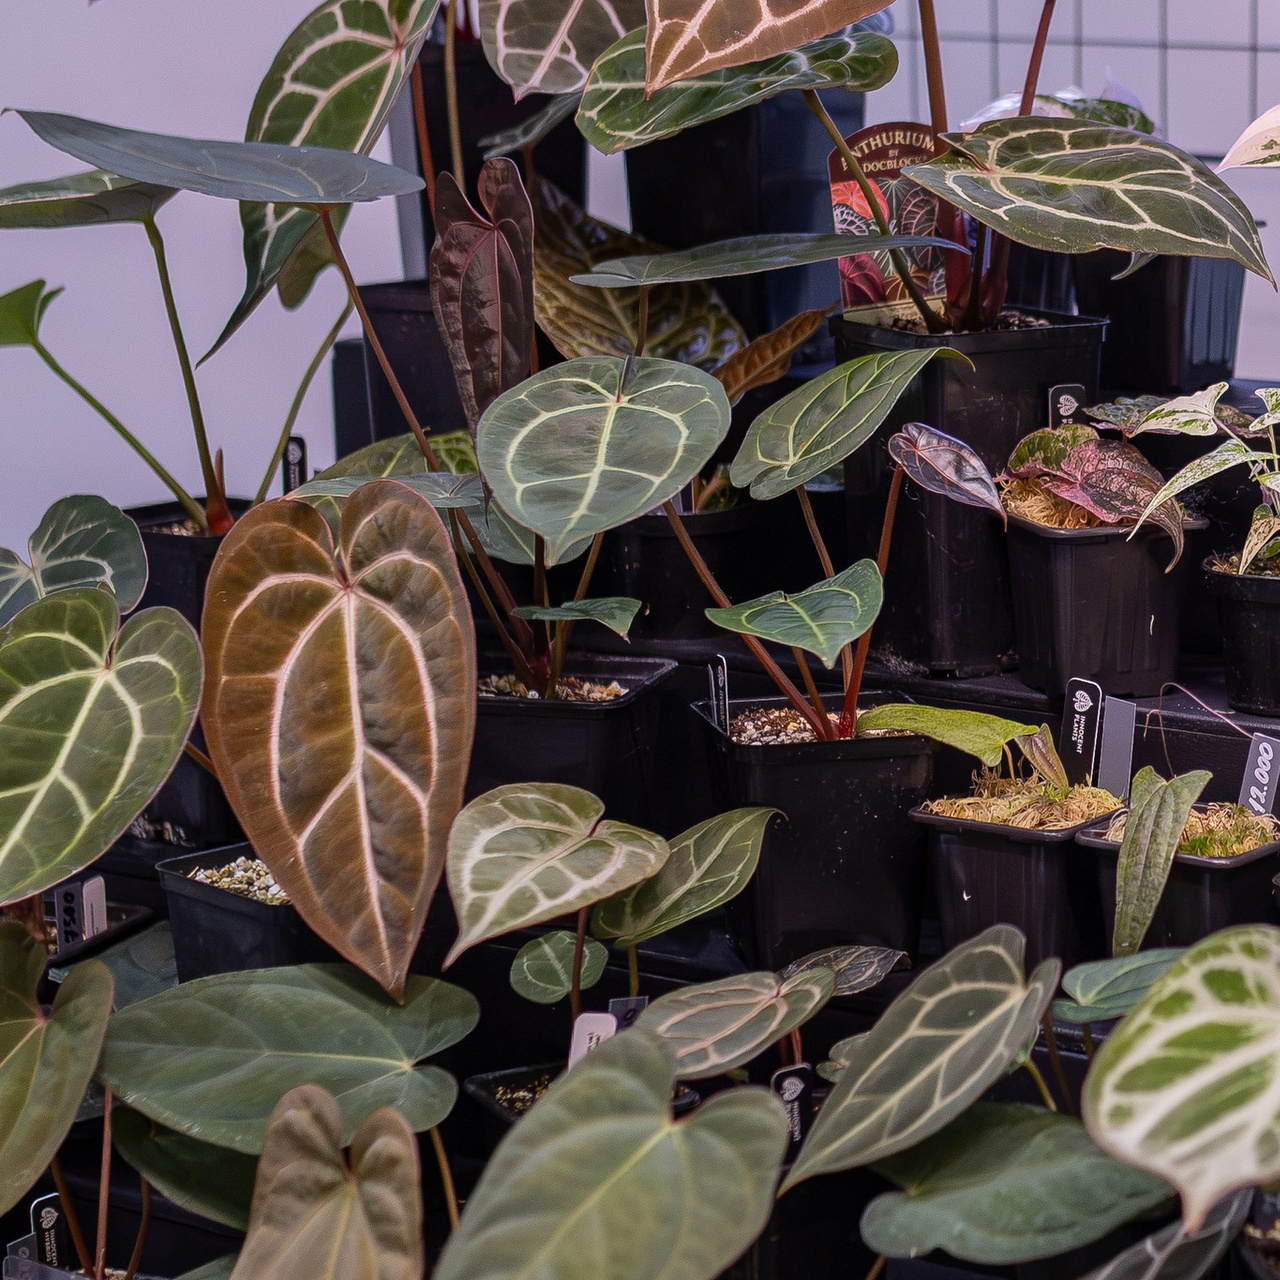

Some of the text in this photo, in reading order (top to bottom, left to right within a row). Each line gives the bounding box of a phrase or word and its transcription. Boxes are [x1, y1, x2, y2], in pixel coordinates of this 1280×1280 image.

[841, 130, 935, 171] NTHURIUM
[888, 149, 899, 157] BY
[1071, 714, 1080, 741] PLANTS
[1076, 715, 1086, 754] INNOCENT
[1248, 741, 1274, 814] 12.000
